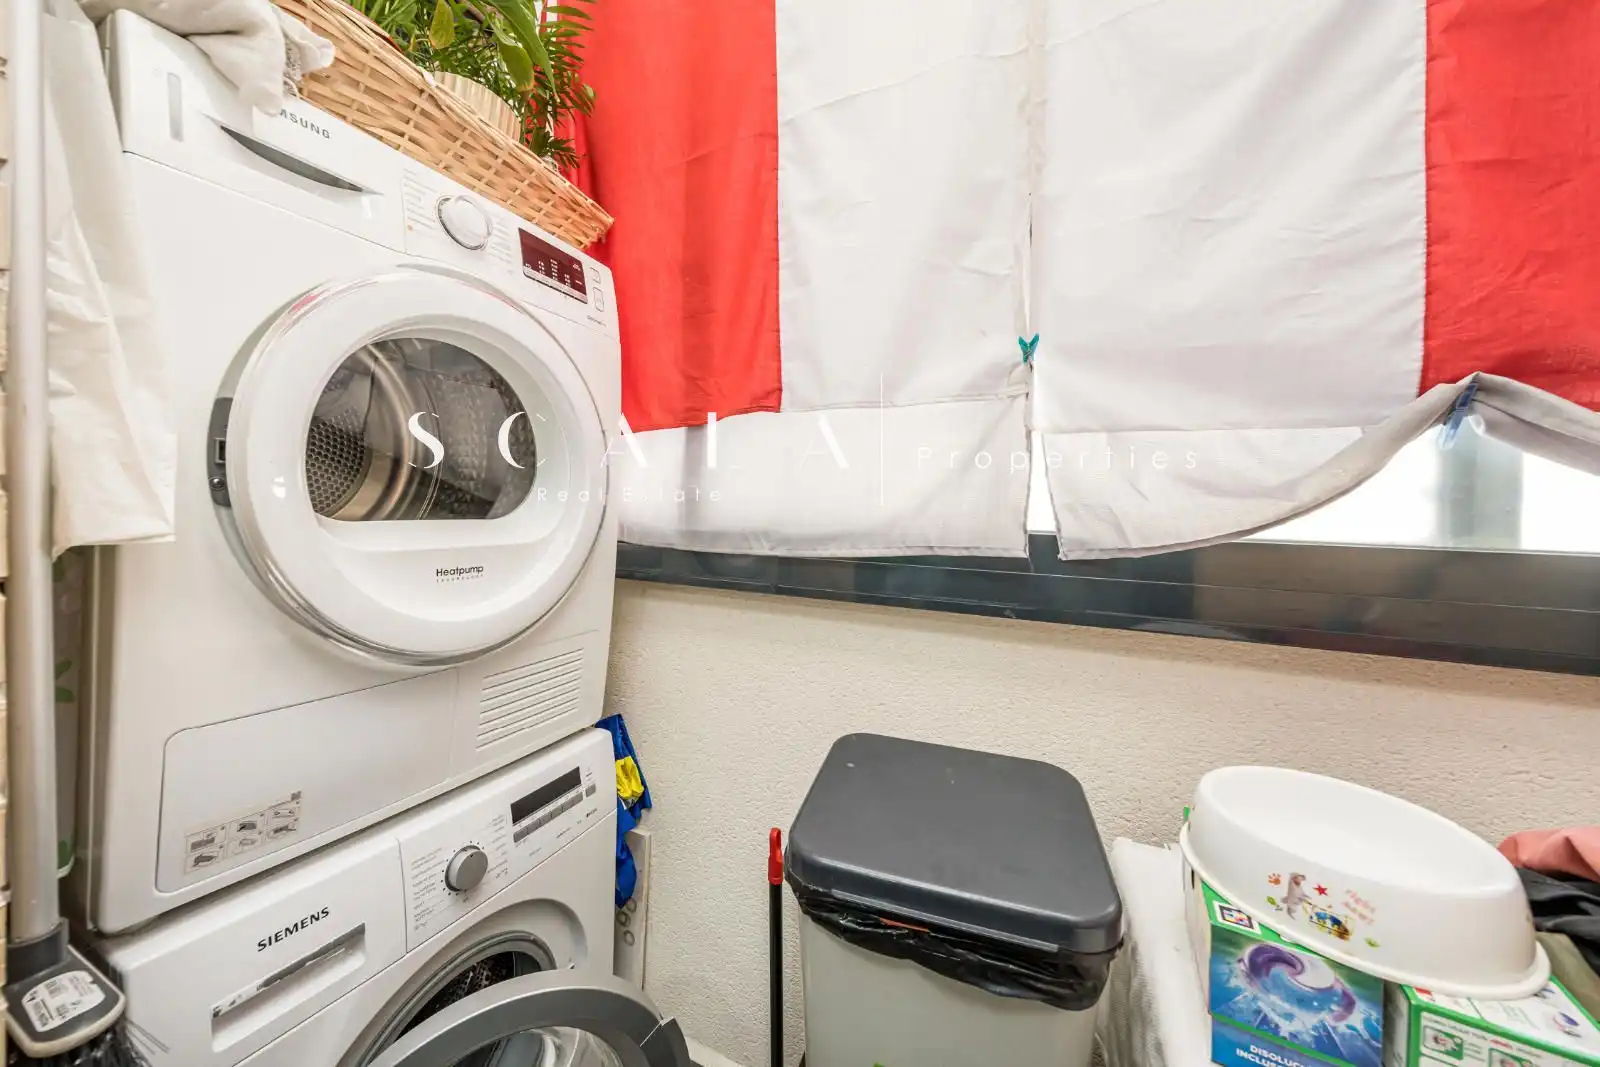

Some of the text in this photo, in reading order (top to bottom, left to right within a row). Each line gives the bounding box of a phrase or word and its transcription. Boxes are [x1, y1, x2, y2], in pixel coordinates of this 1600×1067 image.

[436, 566, 484, 577] Heatpump
[257, 906, 330, 953] SIEMENS
[1250, 1045, 1305, 1067] DISOLUC
